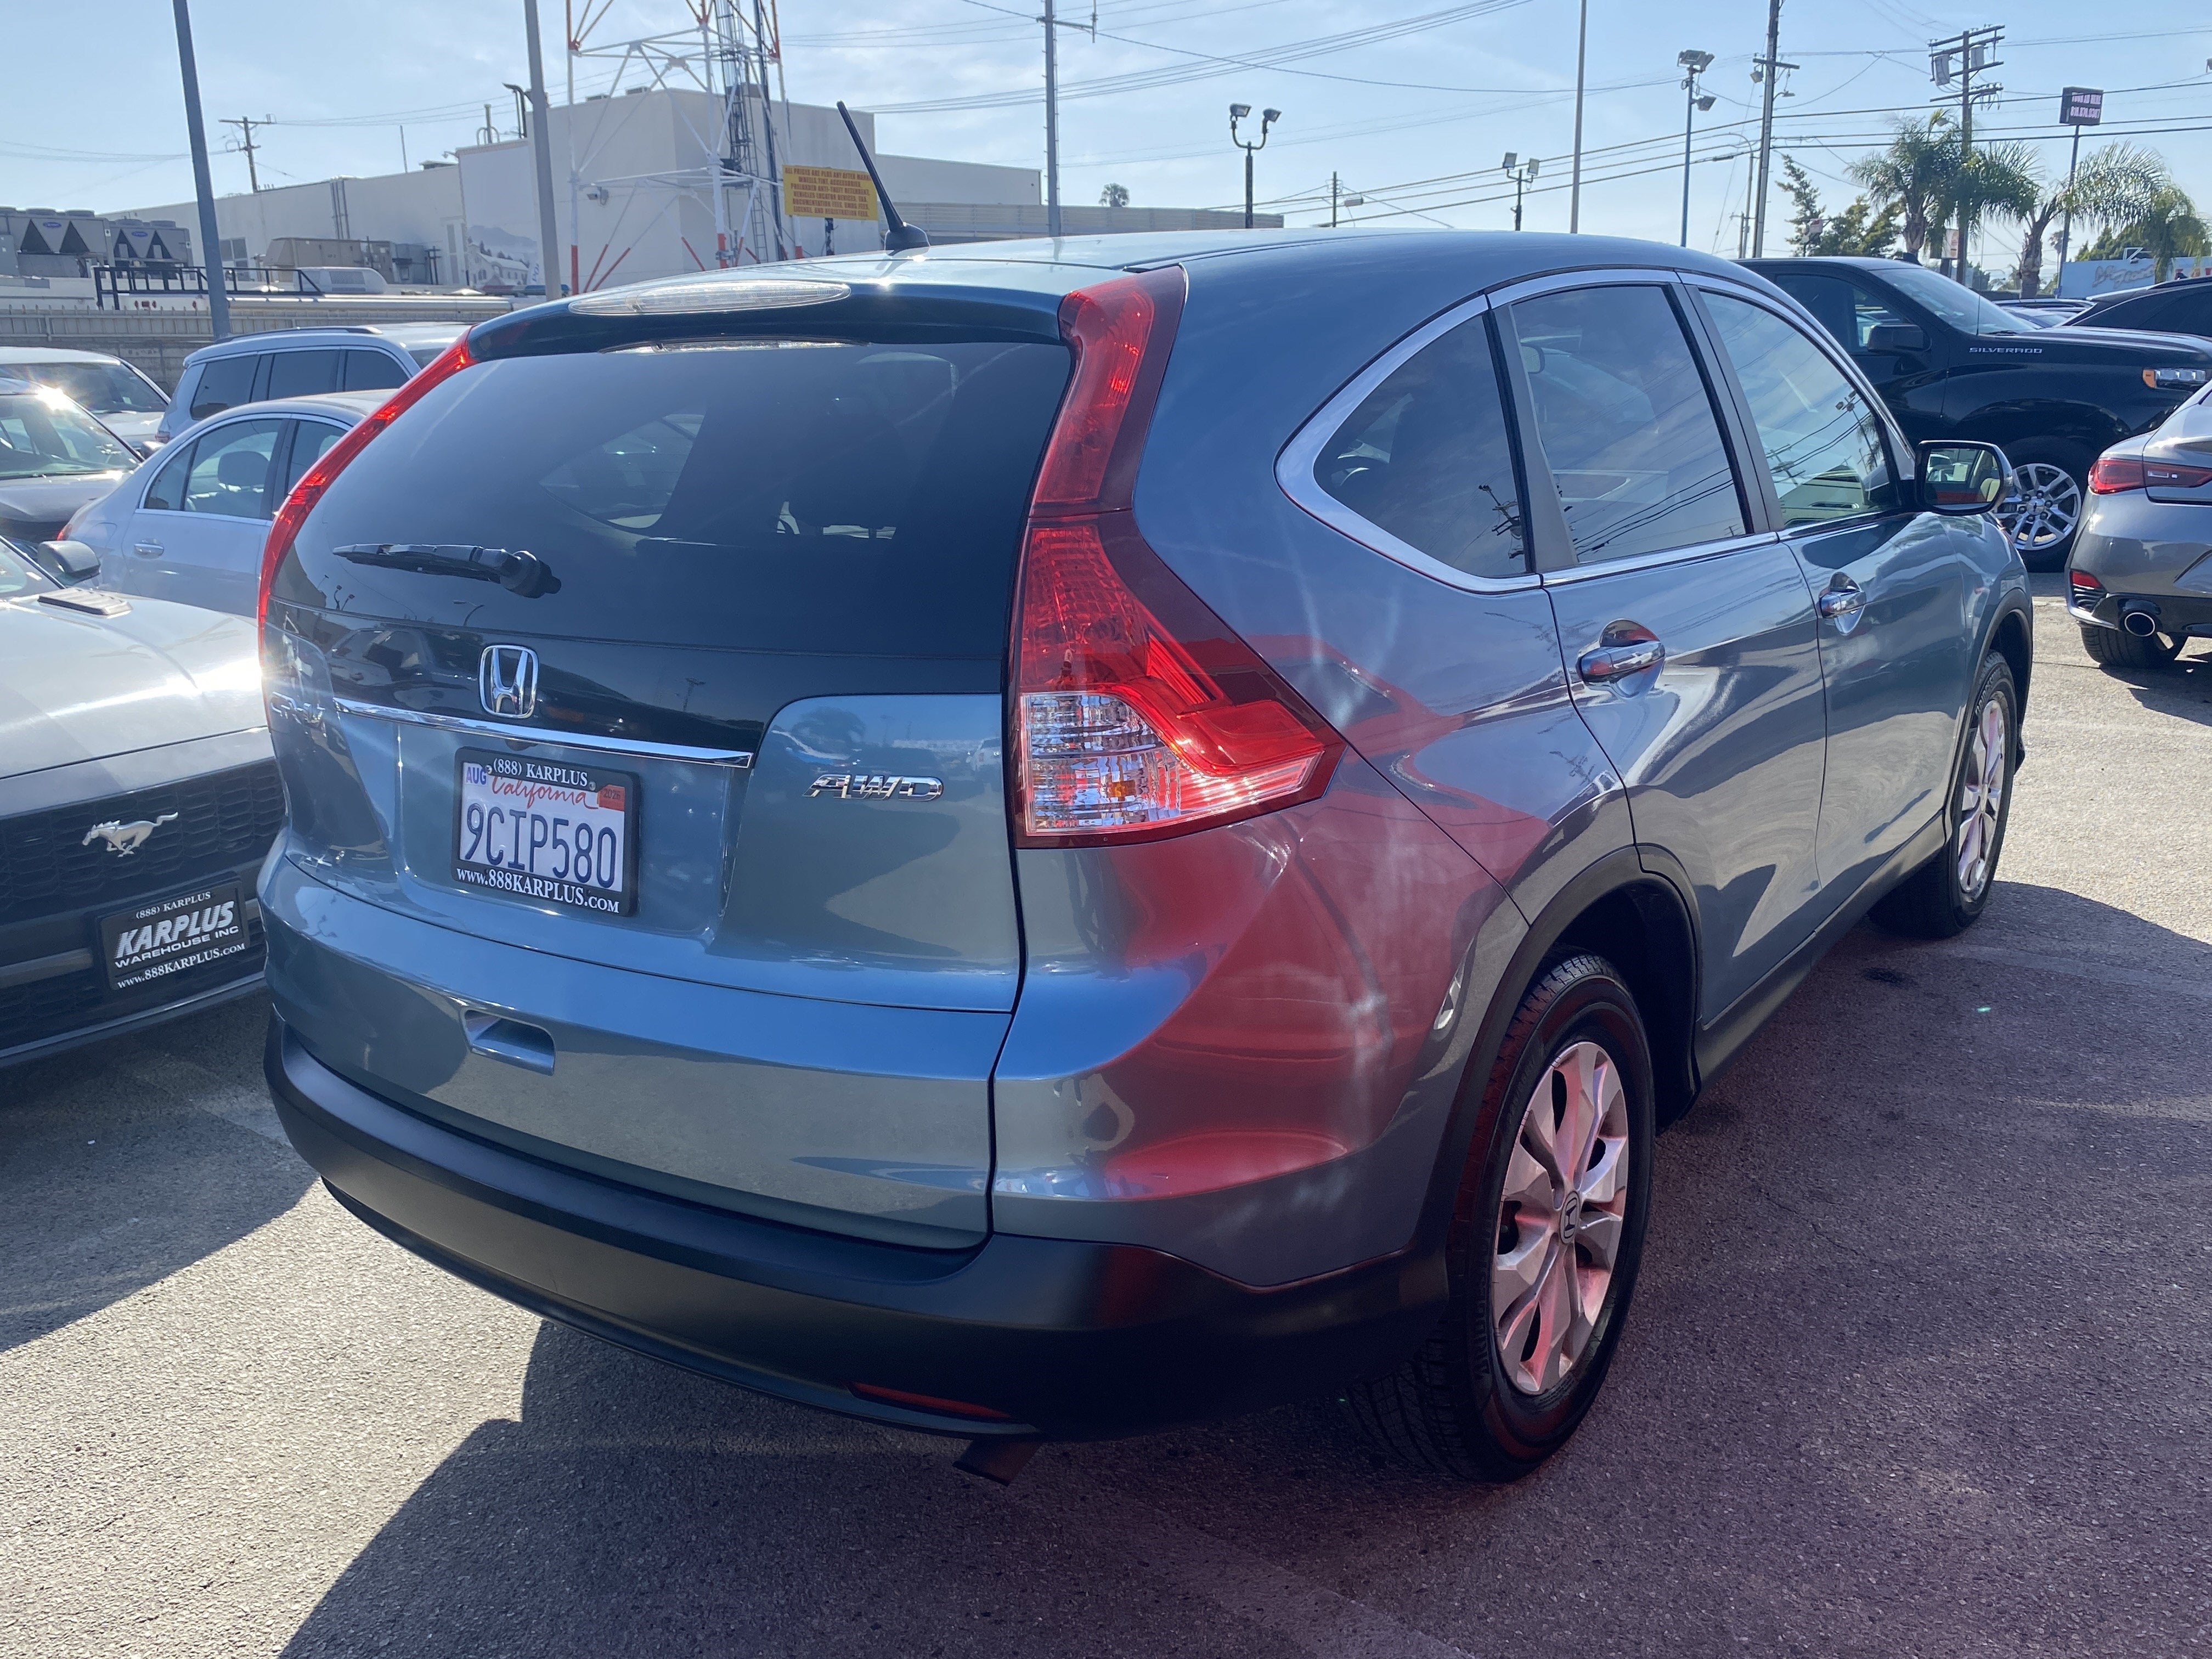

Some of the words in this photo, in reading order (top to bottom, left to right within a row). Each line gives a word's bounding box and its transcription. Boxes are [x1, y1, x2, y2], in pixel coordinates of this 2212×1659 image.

[466, 766, 487, 785] AUG
[493, 758, 522, 776] (888)
[526, 763, 588, 787] KARPLUS
[802, 774, 944, 802] AWD
[492, 776, 599, 810] California
[464, 803, 617, 888] 9CIP580
[136, 906, 160, 920] (888)
[163, 891, 211, 912] KARPLUS
[114, 900, 235, 959] KARPLUS
[115, 934, 210, 968] WAREHOUSE
[215, 926, 239, 939] INC
